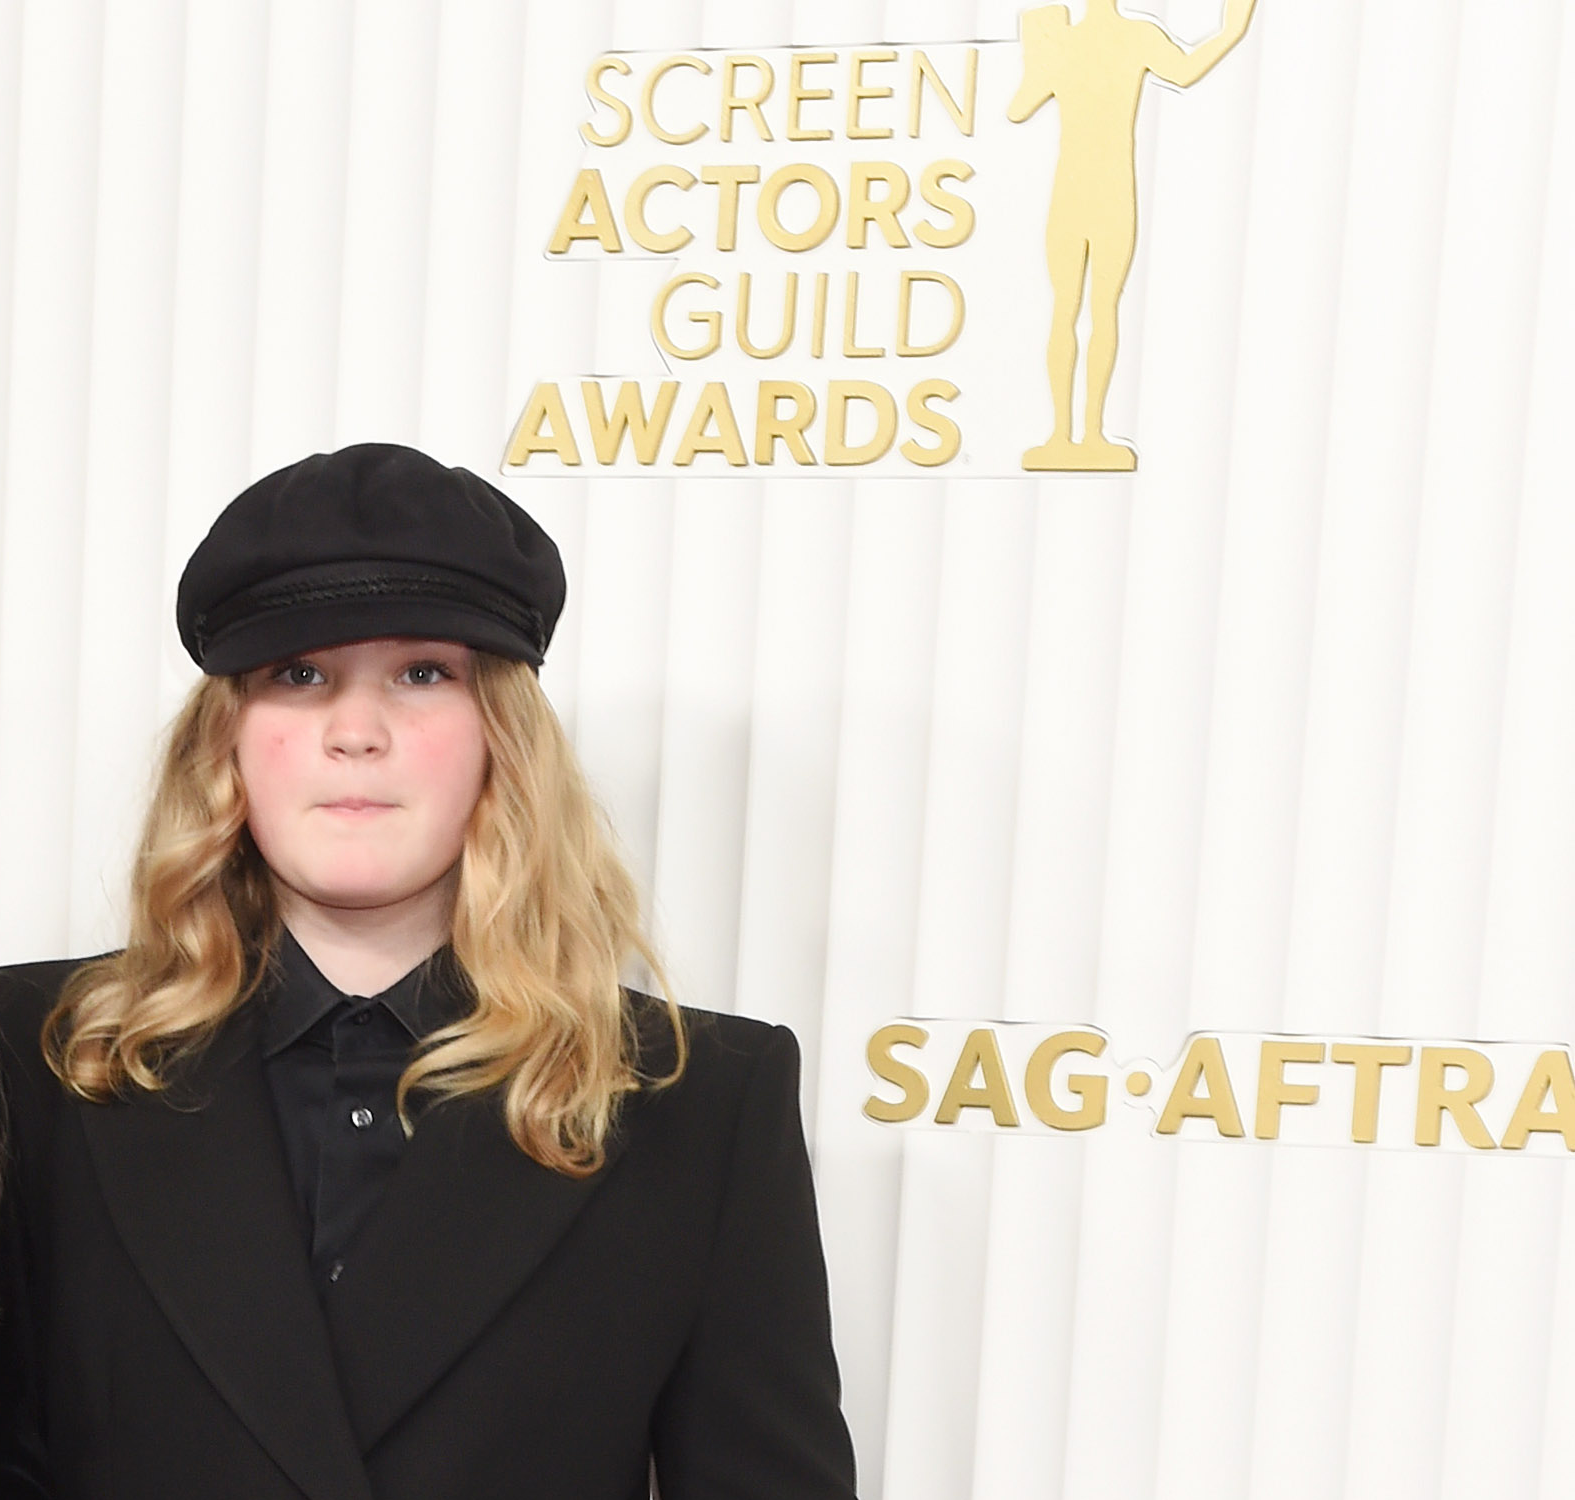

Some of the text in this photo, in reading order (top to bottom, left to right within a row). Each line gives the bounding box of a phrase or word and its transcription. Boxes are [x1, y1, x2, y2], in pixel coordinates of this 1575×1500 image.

[581, 48, 978, 148] SCREEN
[548, 160, 976, 254] ACTORS
[651, 270, 966, 361] GUILD
[508, 378, 962, 467] AWARDS
